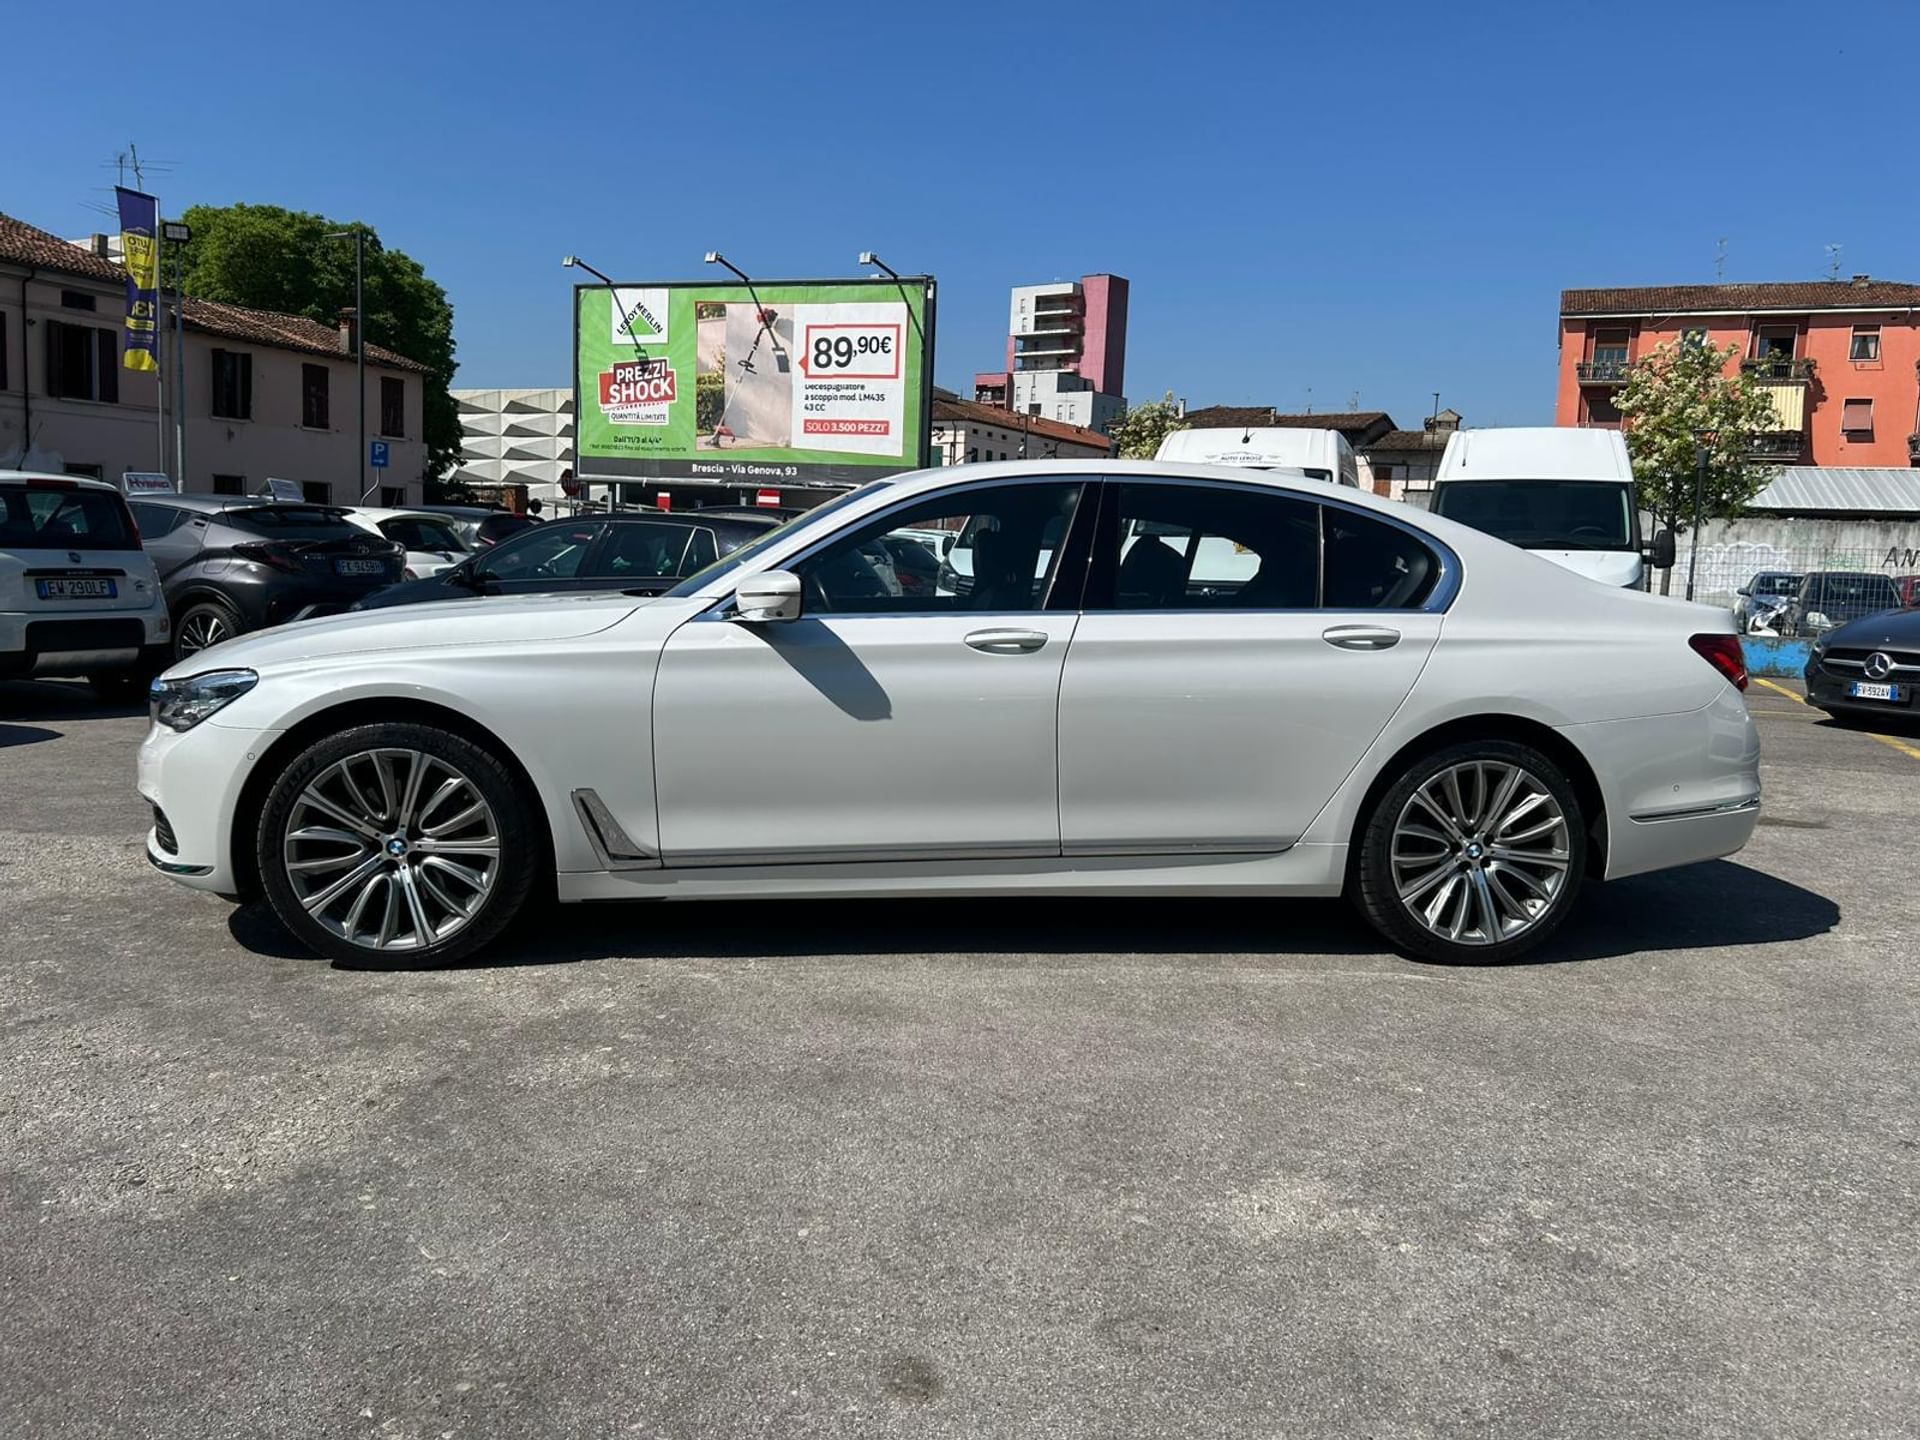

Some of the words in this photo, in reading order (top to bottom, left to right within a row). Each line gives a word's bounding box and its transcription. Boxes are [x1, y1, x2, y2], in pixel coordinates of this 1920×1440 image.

[616, 308, 638, 335] LEROY
[635, 302, 664, 334] MERLIN
[616, 361, 666, 384] PREZZI
[609, 377, 673, 403] SHOCK
[814, 403, 826, 412] CC
[640, 413, 667, 421] LIMITATE
[806, 422, 830, 432] SOLO
[831, 422, 857, 432] 3.500
[375, 443, 385, 456] P
[691, 463, 724, 473] Brescia
[730, 464, 746, 474] Via
[747, 465, 784, 477] Genova,
[784, 466, 798, 476] 93
